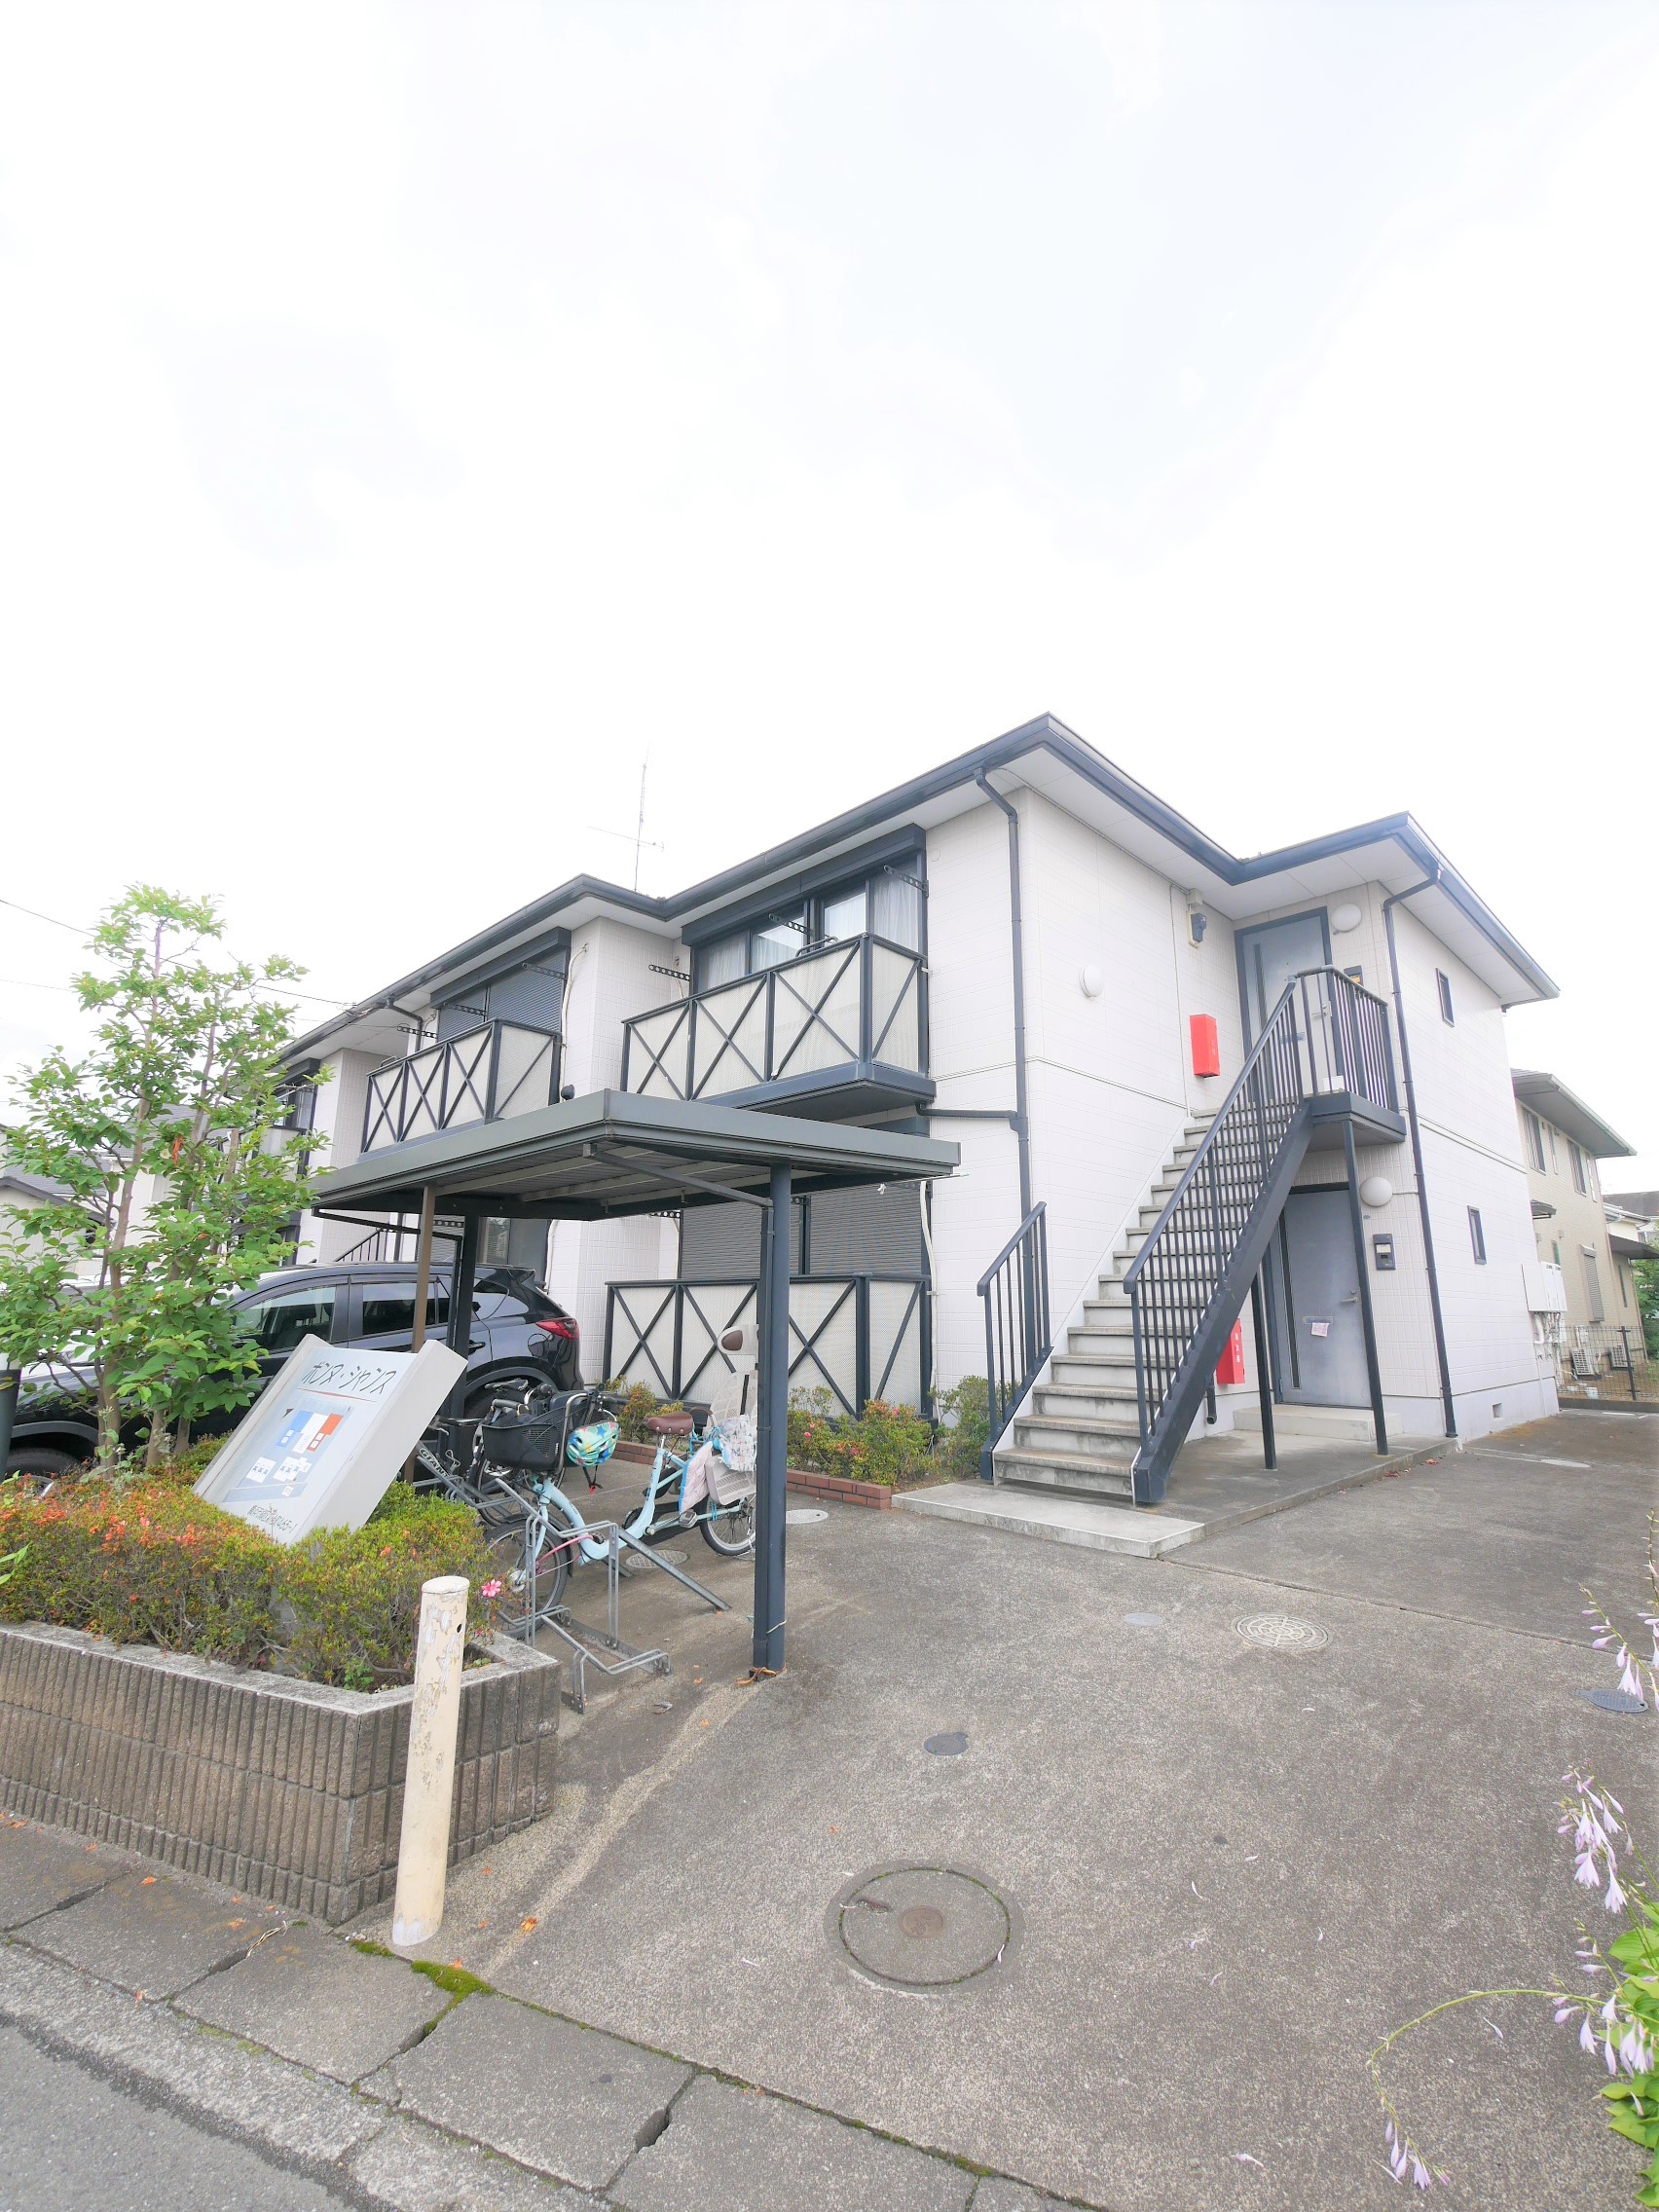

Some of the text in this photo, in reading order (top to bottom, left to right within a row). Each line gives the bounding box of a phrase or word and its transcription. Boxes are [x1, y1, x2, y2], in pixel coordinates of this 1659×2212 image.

[302, 1361, 397, 1394] ボンヌ・シャンス
[420, 1448, 449, 1478] GIANT
